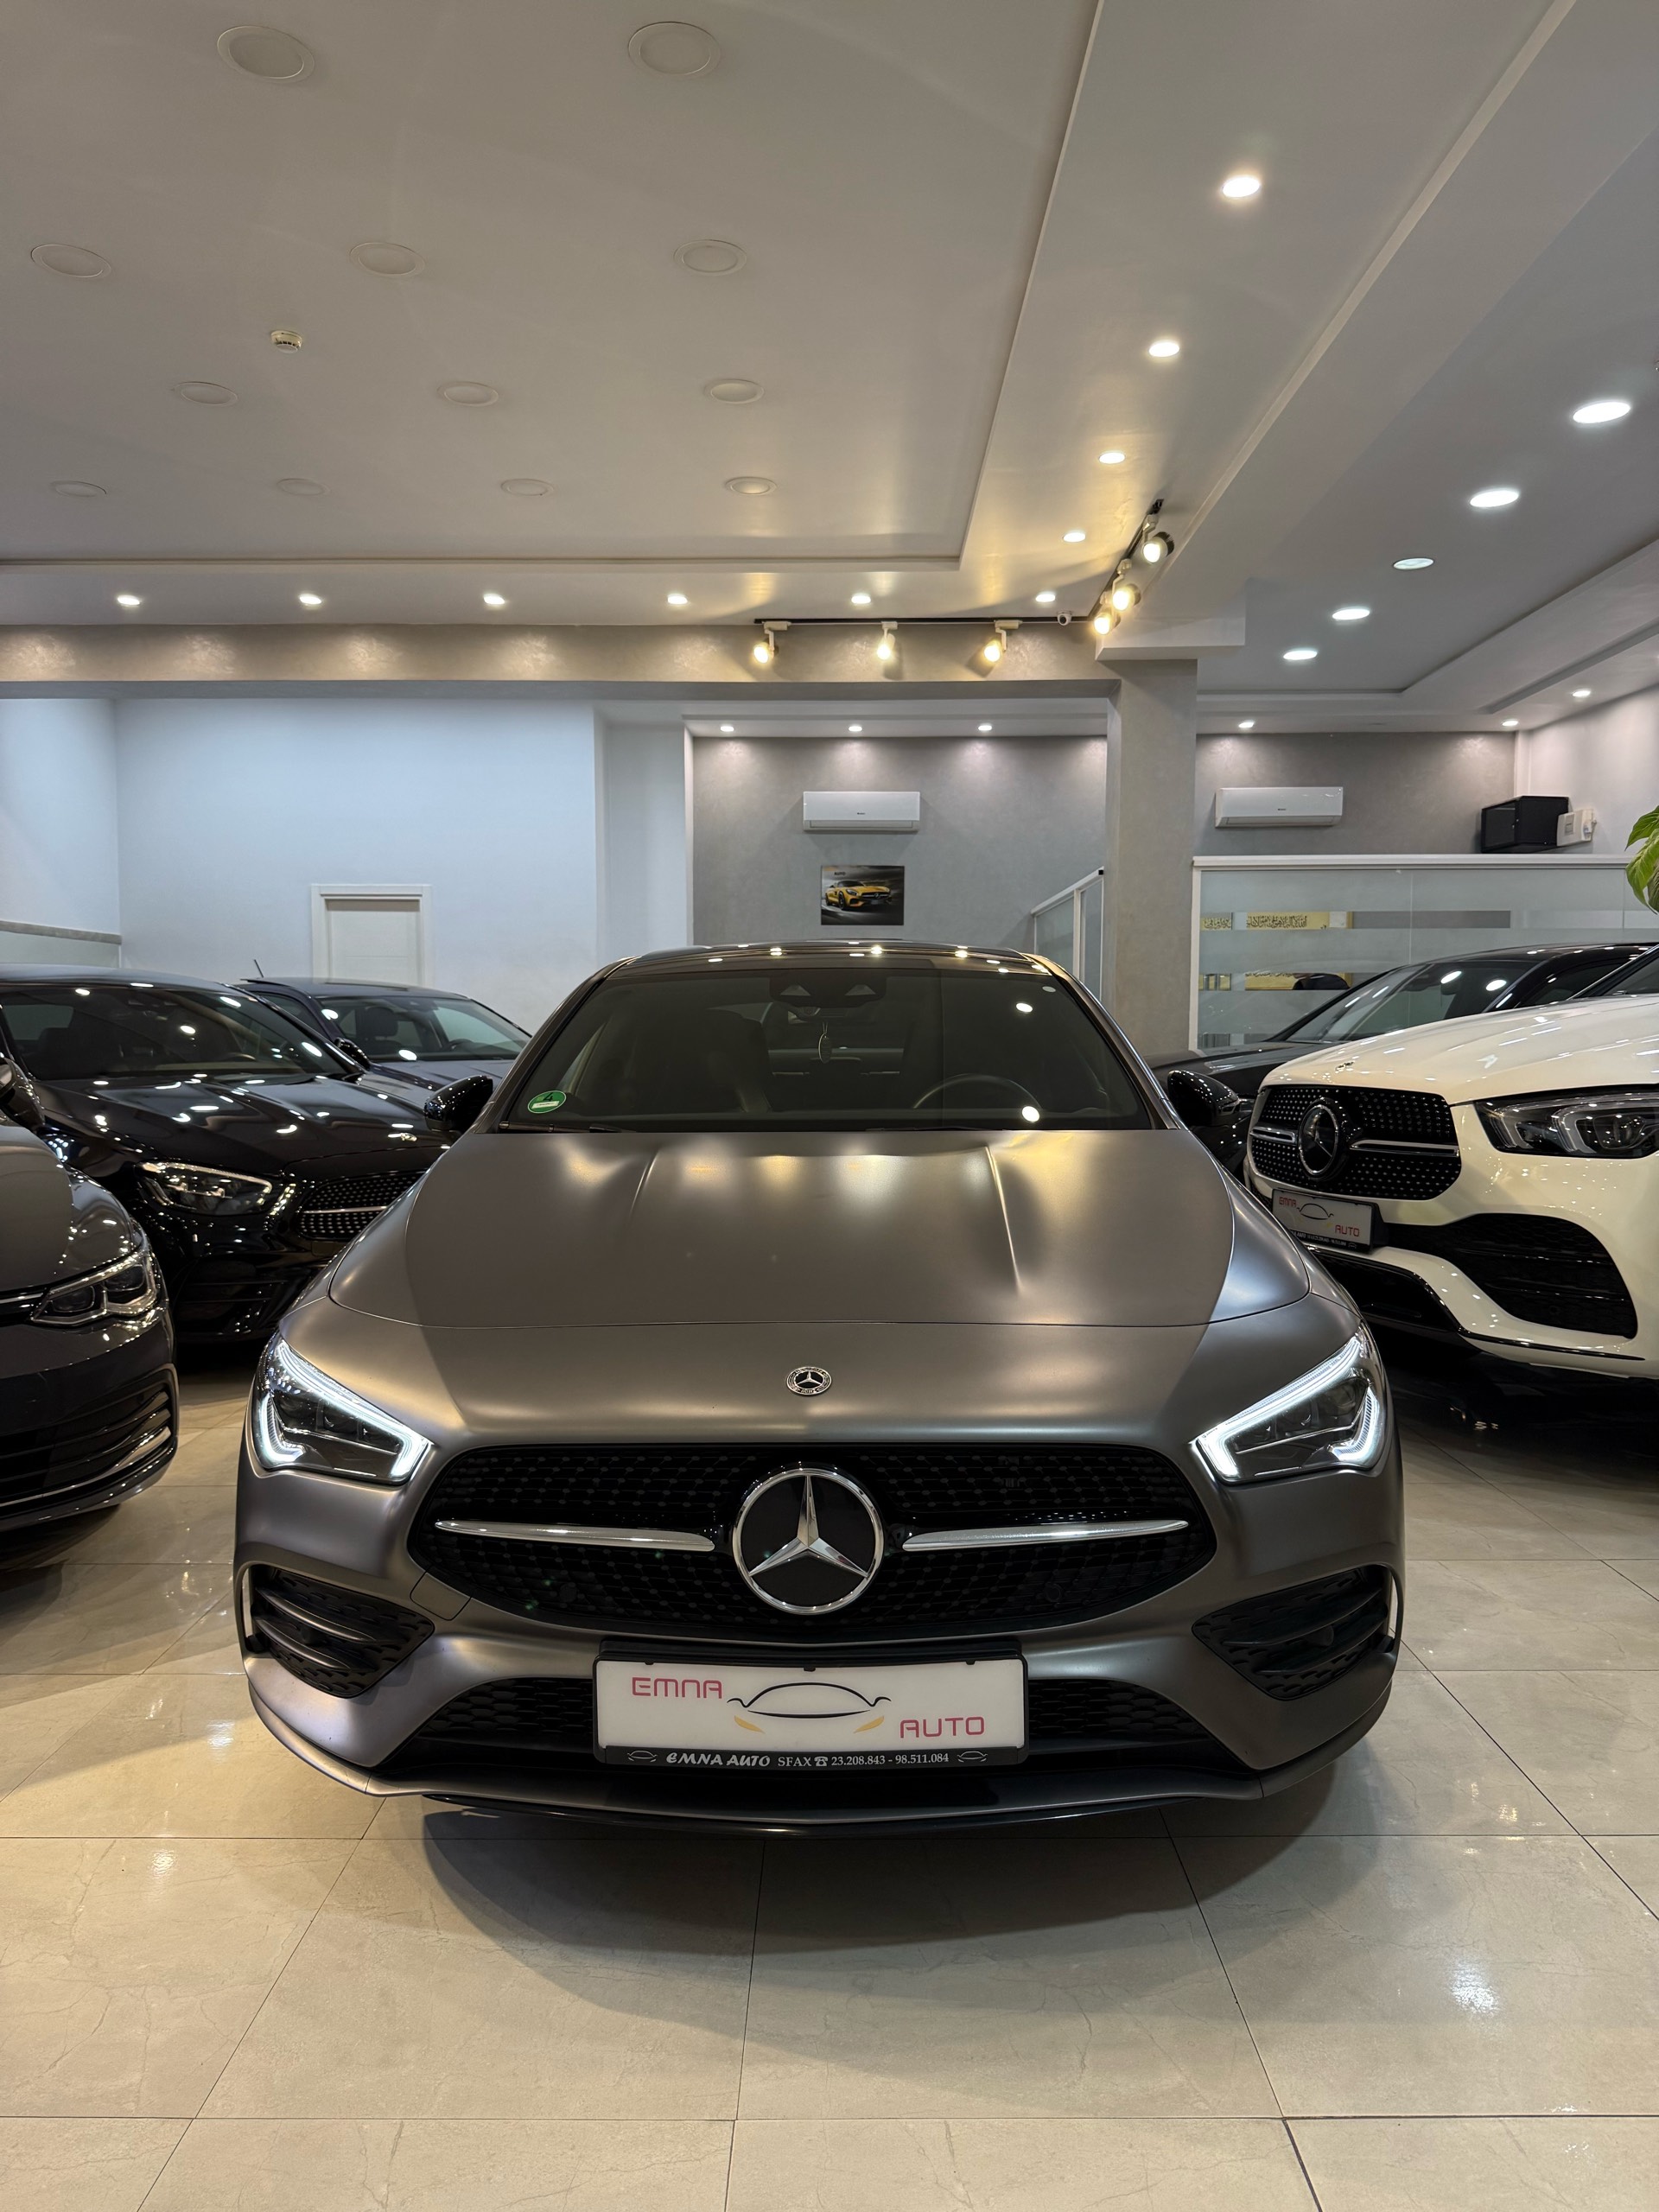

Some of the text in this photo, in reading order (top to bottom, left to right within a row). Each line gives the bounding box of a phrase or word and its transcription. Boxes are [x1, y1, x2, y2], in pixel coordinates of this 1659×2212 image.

[543, 1092, 553, 1102] 4
[1279, 1197, 1297, 1208] EMNA
[1335, 1224, 1360, 1237] AUTO
[632, 1677, 722, 1699] EMNA
[899, 1716, 985, 1738] AUTO
[727, 1754, 771, 1767] AUTO
[778, 1756, 812, 1767] SFAX
[831, 1755, 886, 1766] 23.208.843
[895, 1753, 950, 1764] 98.511.084
